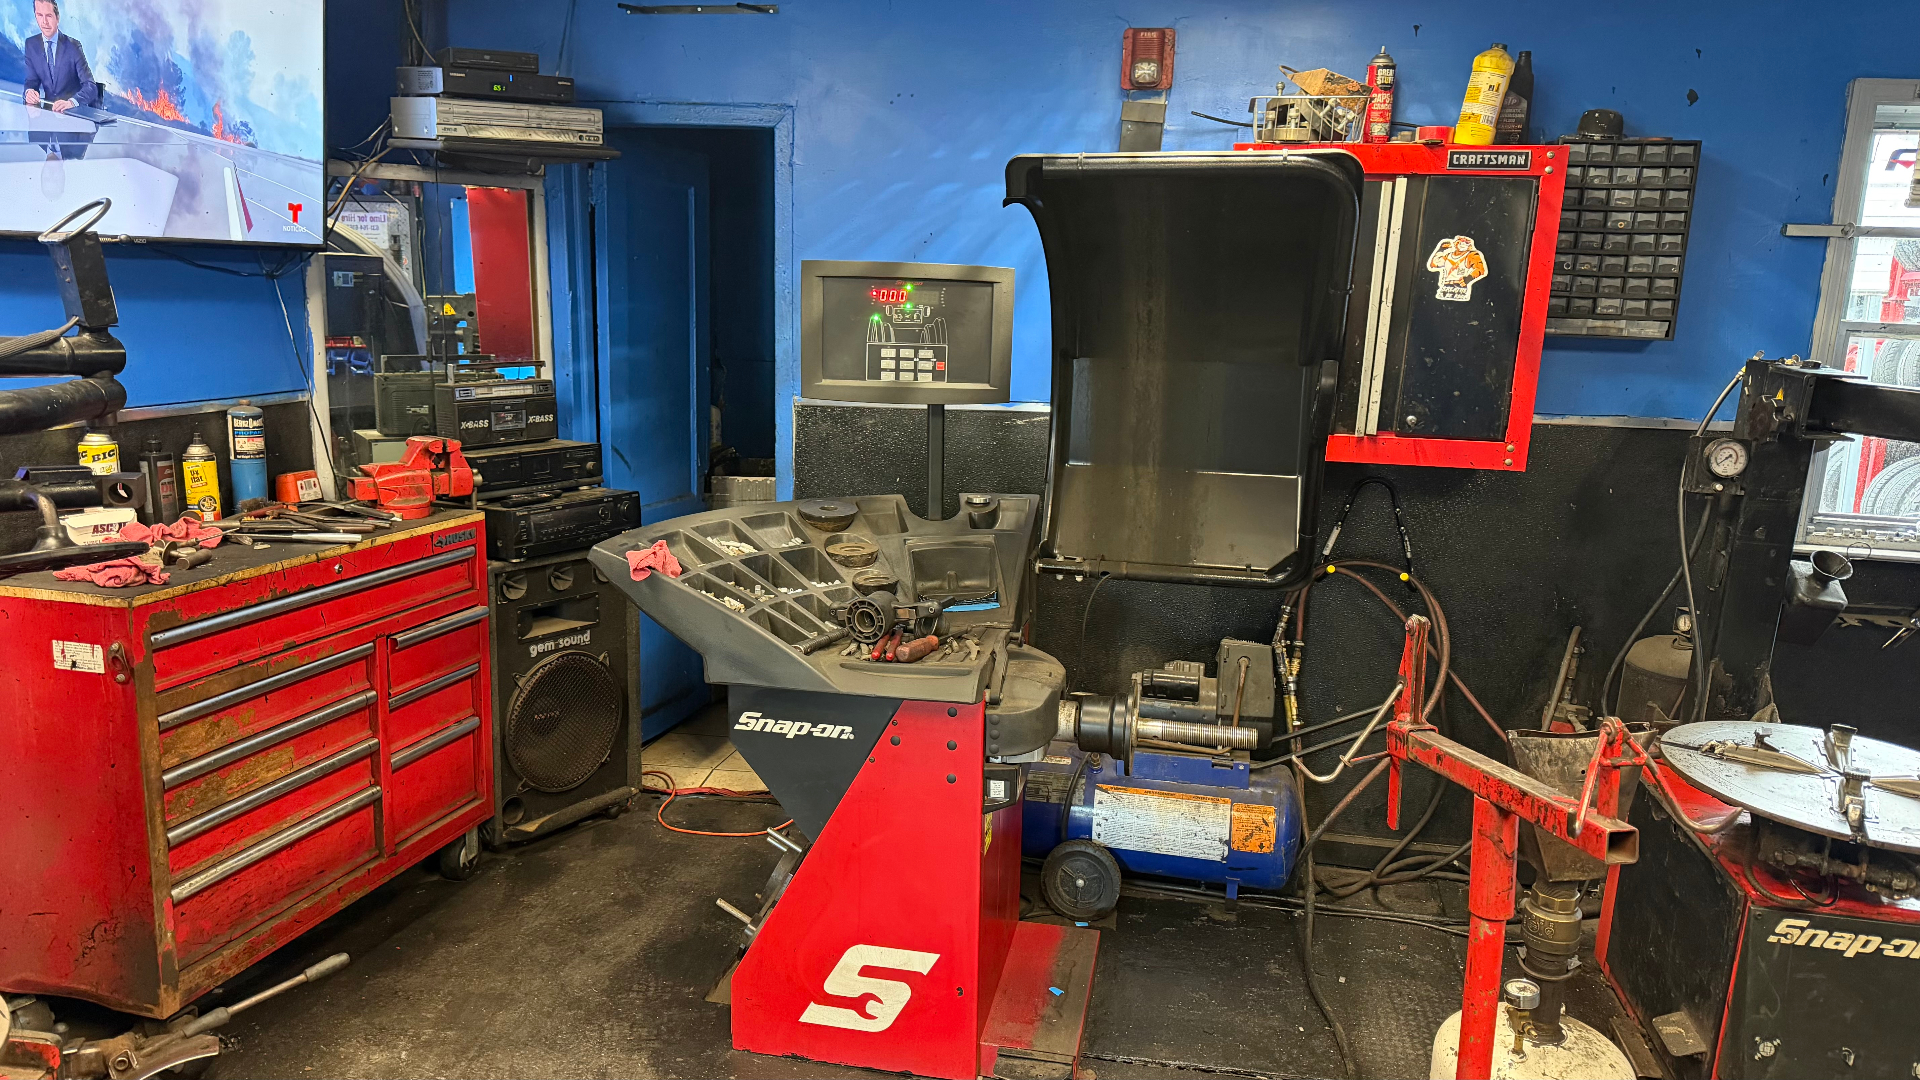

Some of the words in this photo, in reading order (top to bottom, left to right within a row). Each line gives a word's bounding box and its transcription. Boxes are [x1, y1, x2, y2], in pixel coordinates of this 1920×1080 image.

[1453, 154, 1526, 165] CRAFTSMAN
[445, 528, 477, 546] HUSKY
[529, 642, 555, 658] gem
[558, 629, 591, 648] sound
